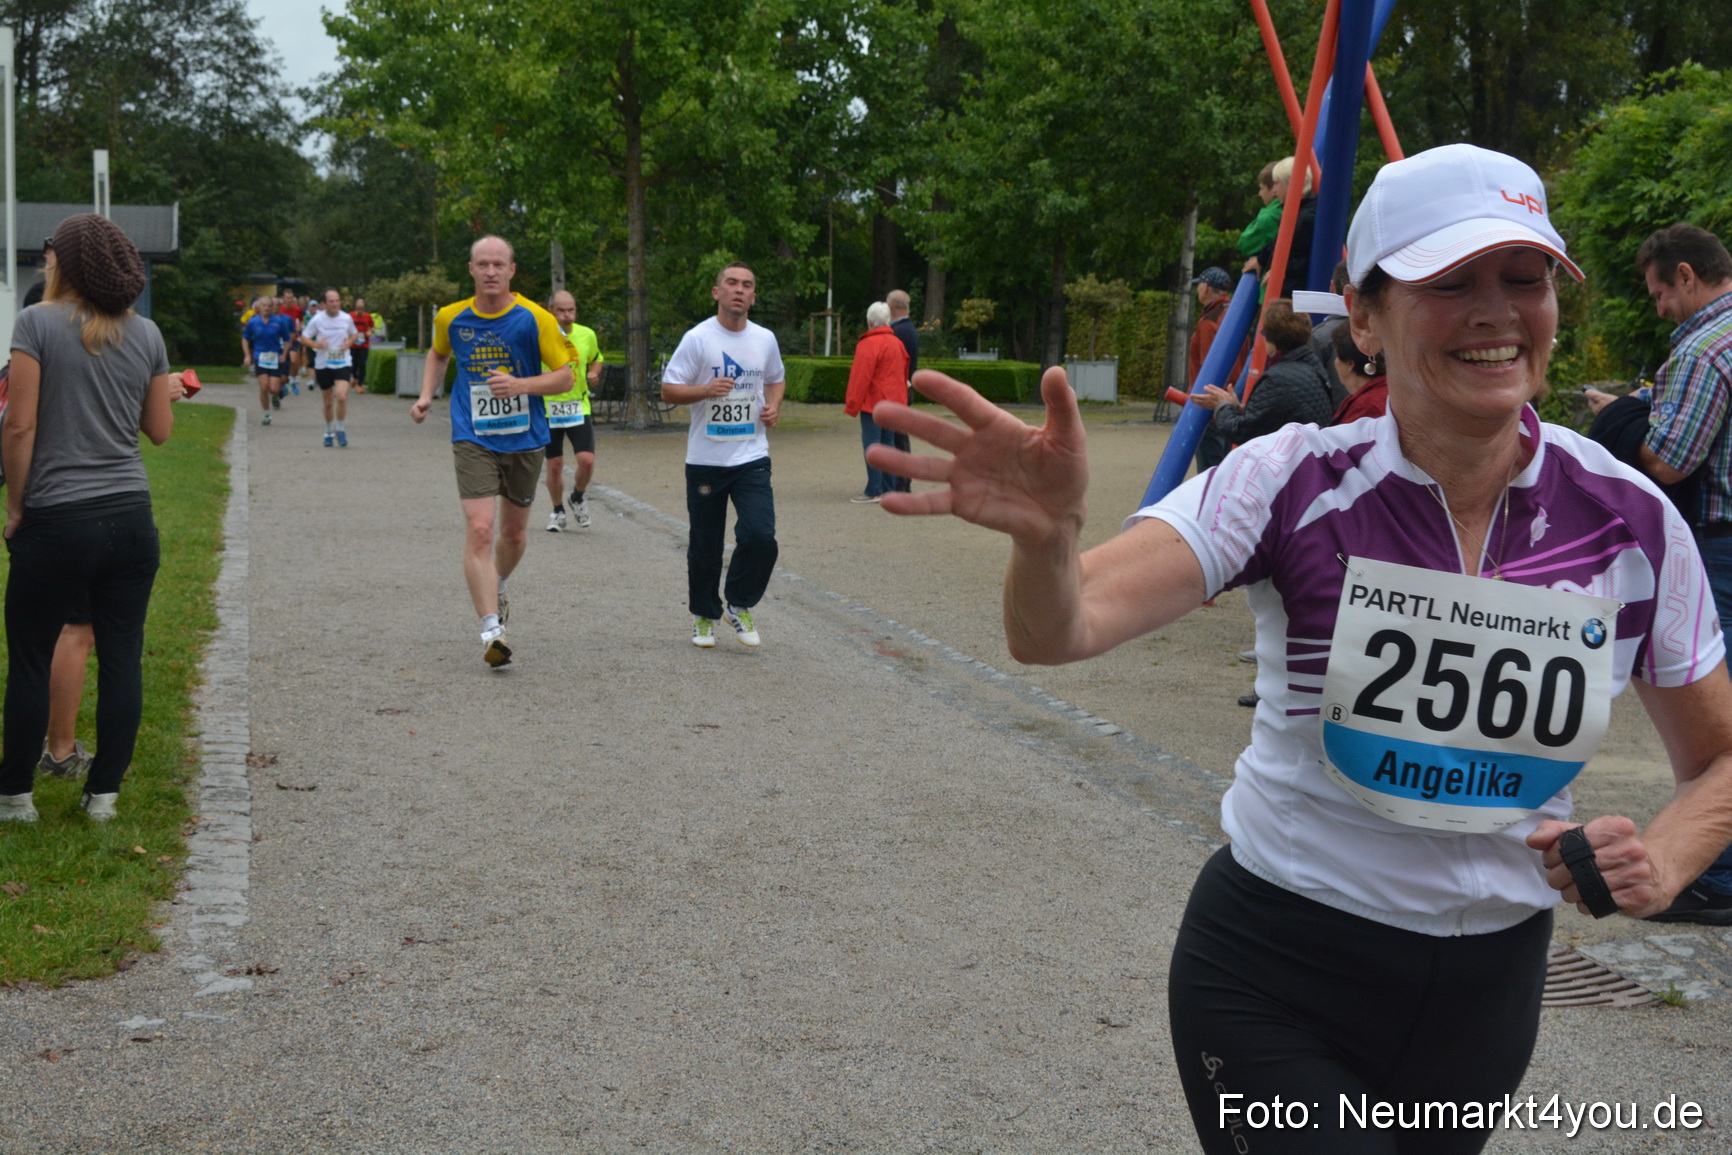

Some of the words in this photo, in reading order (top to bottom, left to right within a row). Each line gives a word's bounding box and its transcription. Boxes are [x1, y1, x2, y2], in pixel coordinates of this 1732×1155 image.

[477, 394, 522, 417] 2081
[551, 402, 579, 416] 2437
[711, 403, 751, 423] 2831
[717, 426, 747, 435] Christian
[1348, 583, 1442, 621] PARTL
[1450, 601, 1571, 641] Neumarkt
[1352, 628, 1586, 748] 2560
[1331, 706, 1342, 722] B
[1372, 750, 1523, 800] Angelika
